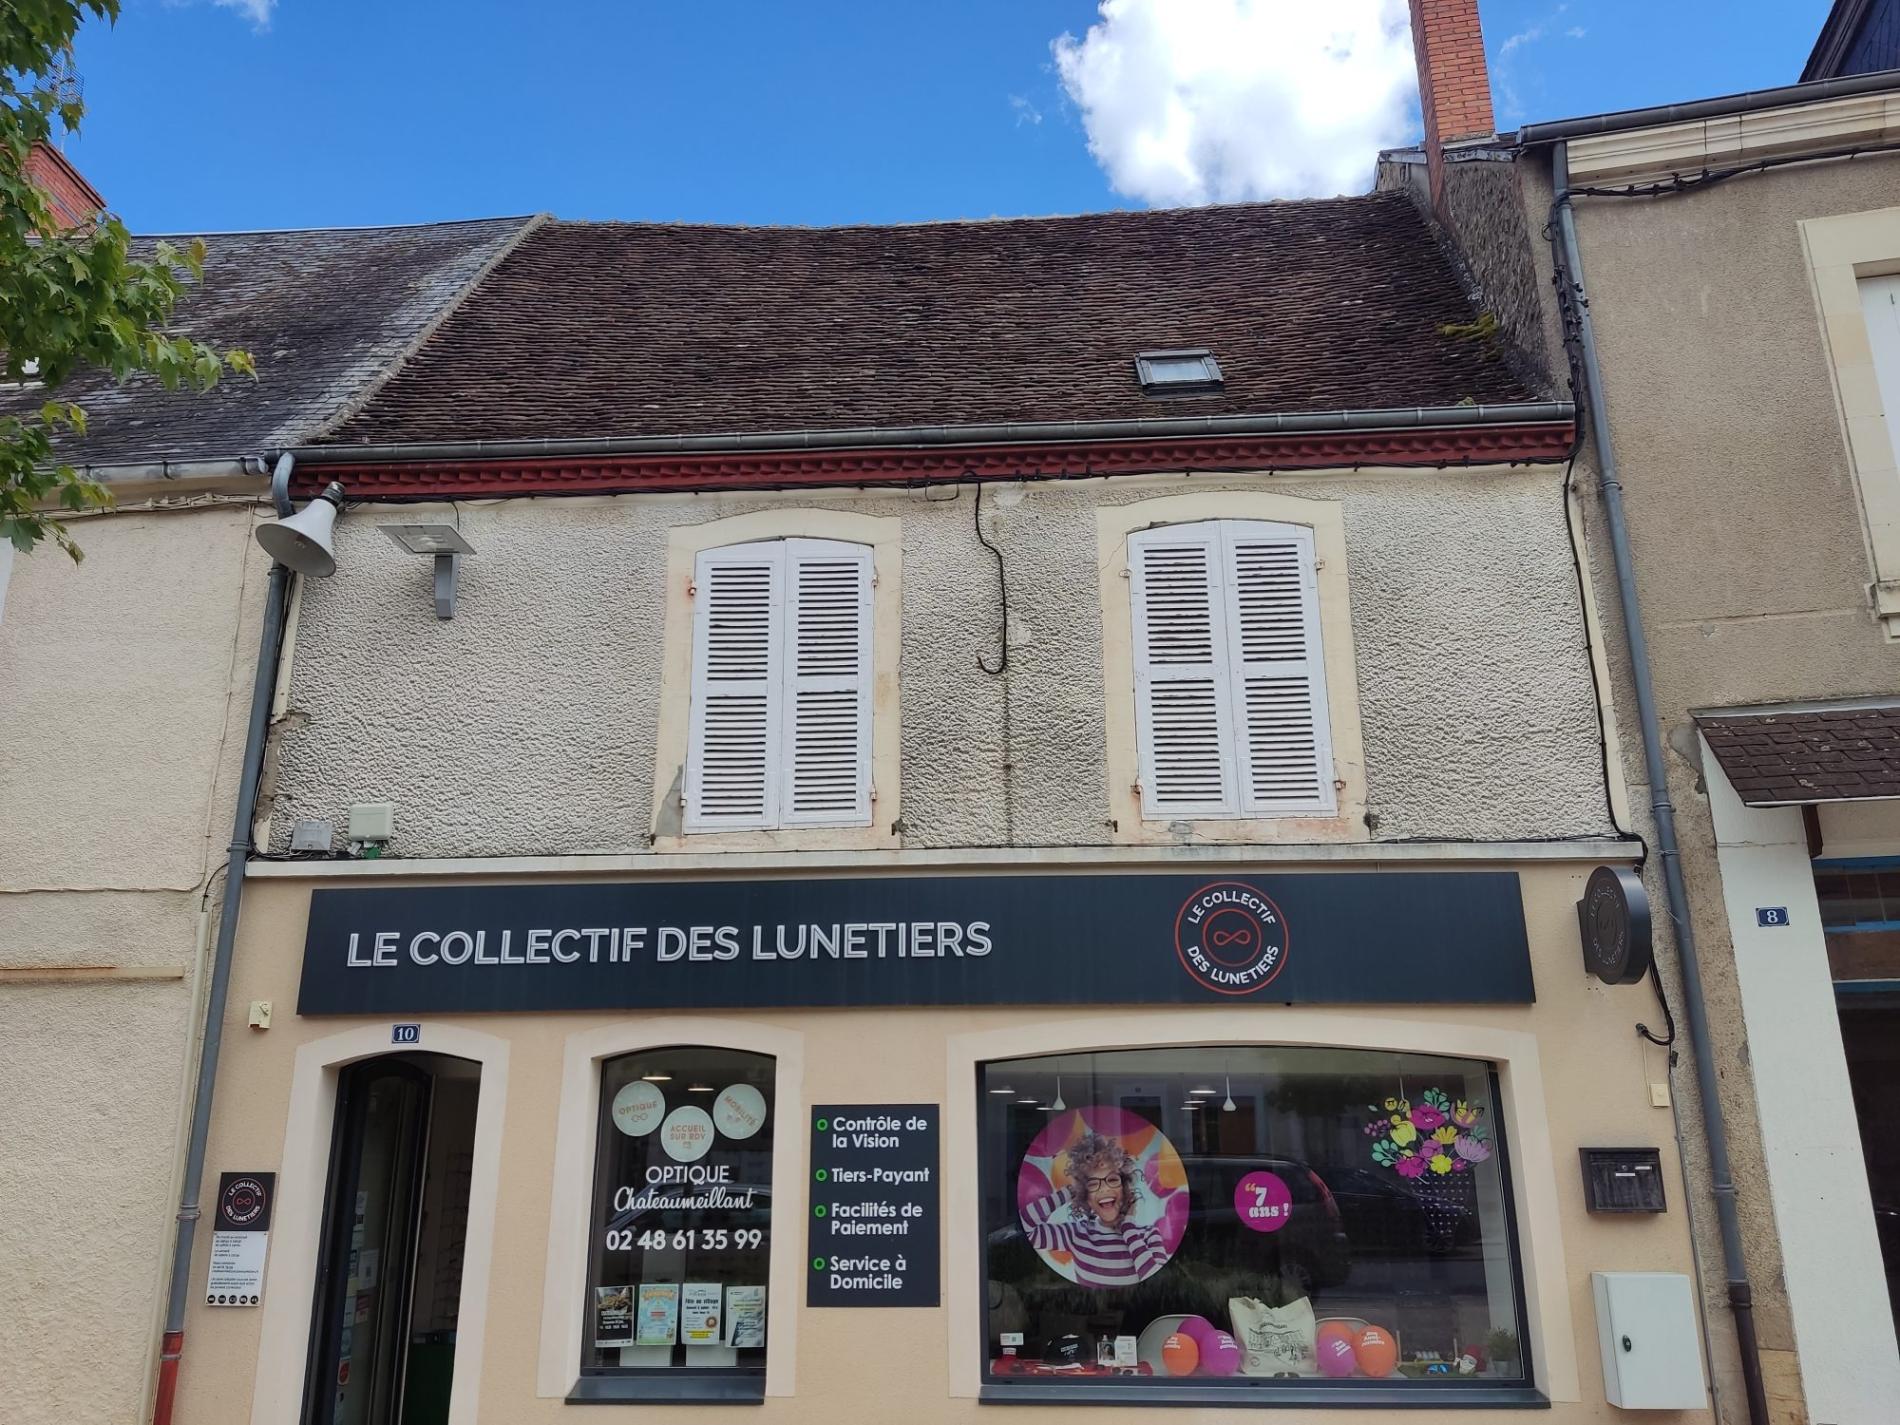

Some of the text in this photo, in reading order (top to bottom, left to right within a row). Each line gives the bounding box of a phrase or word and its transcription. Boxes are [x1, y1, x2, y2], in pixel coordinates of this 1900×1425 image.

[1187, 890, 1276, 924] LE COLLECTIF
[1766, 909, 1778, 924] 8
[347, 921, 993, 967] LE COLLECTIF DES LUNETIERS
[1187, 945, 1279, 984] DES LUNETIERS
[397, 1027, 415, 1041] 10
[618, 1101, 658, 1116] OPTIQUE
[724, 1095, 759, 1126] MOBILITÉ
[670, 1124, 706, 1134] ACCUEIL
[832, 1115, 928, 1131] Contrôle de
[670, 1132, 706, 1141] SUR RDV
[832, 1133, 900, 1148] la Vision
[645, 1165, 730, 1185] OPTIQUE
[831, 1167, 930, 1186] Tiers-Payant
[613, 1186, 757, 1212] Chateaumeillant
[831, 1201, 923, 1218] Facilités de
[1248, 1205, 1279, 1218] ans
[831, 1220, 909, 1235] Paiement
[606, 1229, 762, 1251] 02 48 61 35 99
[830, 1254, 907, 1271] Service à
[830, 1273, 903, 1289] Domicile
